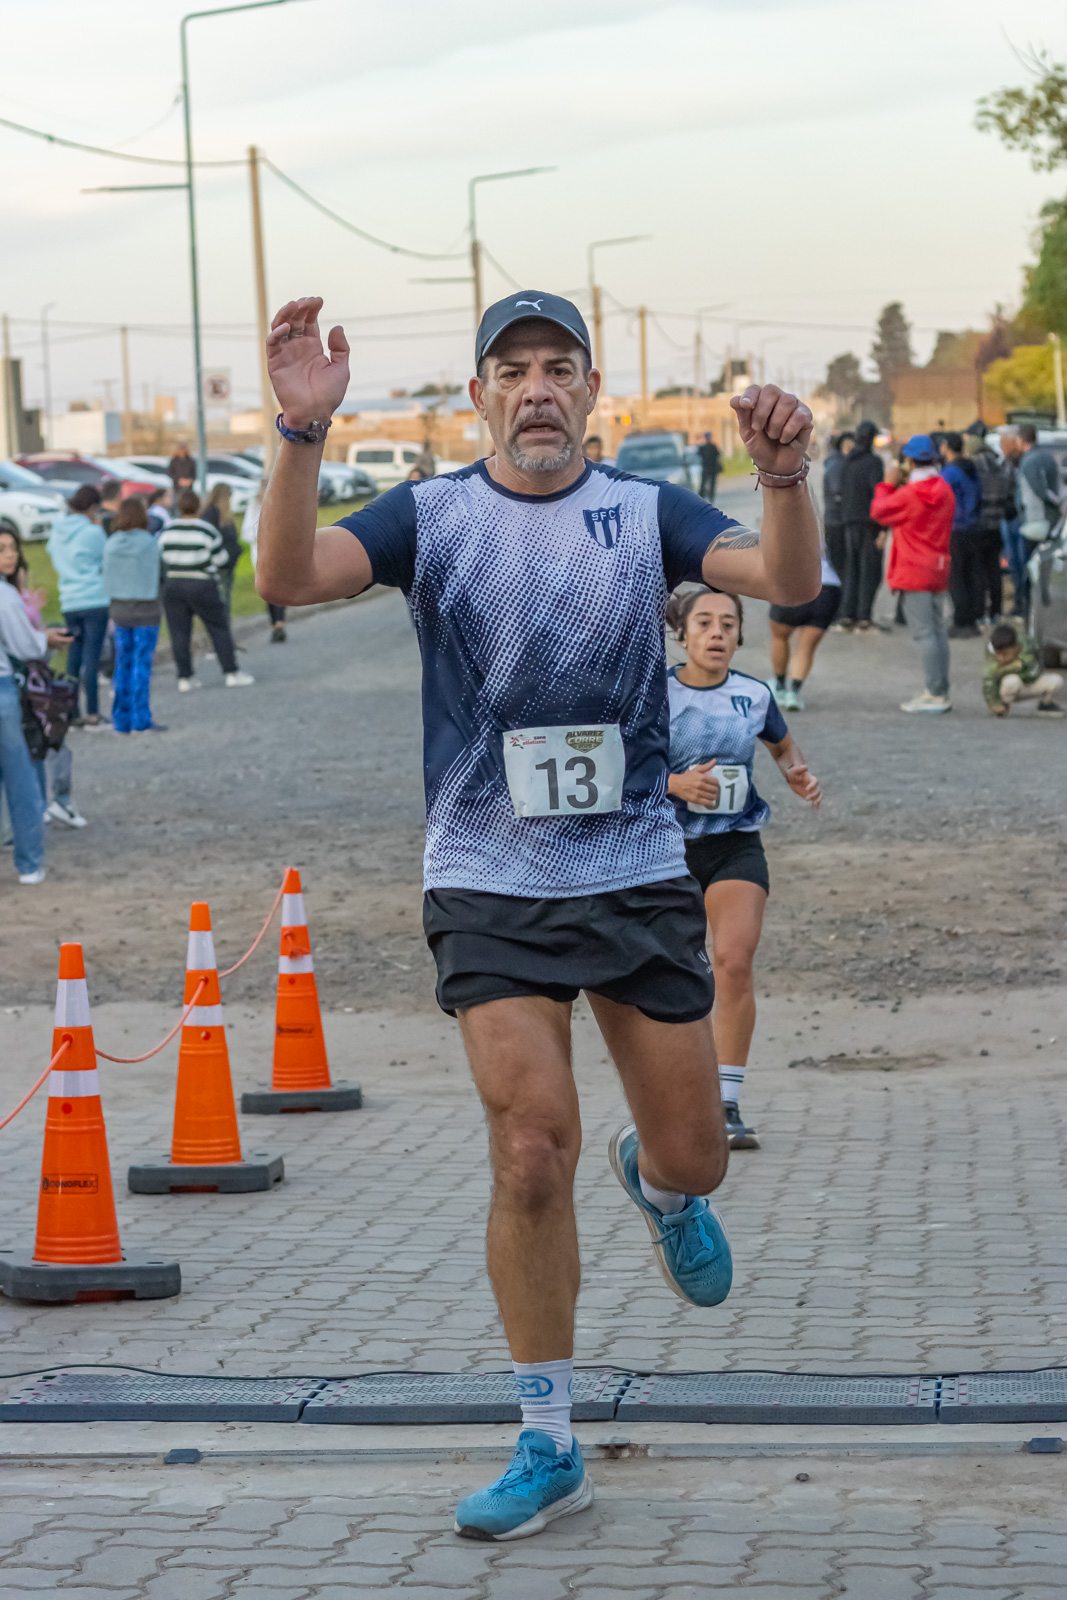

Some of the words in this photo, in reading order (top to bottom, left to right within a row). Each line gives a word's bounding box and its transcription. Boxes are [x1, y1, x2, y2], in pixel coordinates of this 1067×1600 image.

[591, 510, 616, 521] SFC
[565, 730, 604, 738] ALVAREZ
[567, 736, 603, 744] CORRE
[535, 756, 599, 810] 13
[48, 1180, 95, 1188] CONOFLEX
